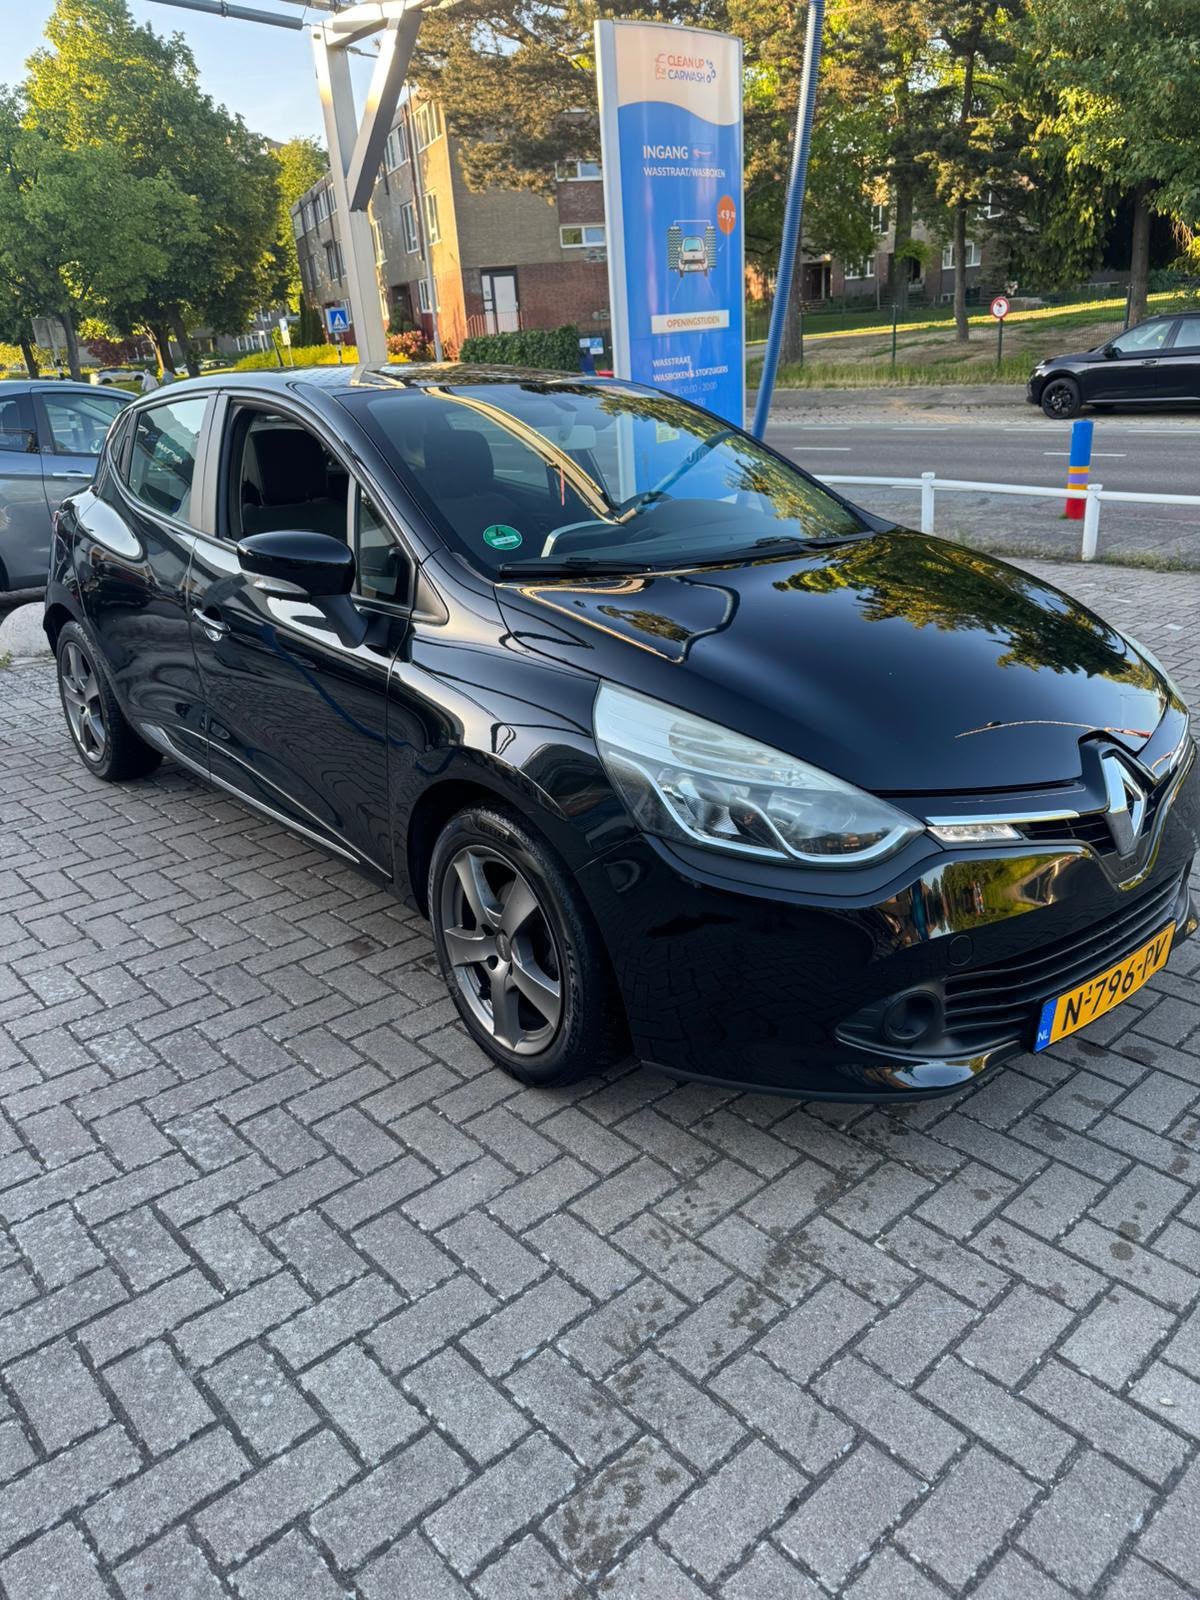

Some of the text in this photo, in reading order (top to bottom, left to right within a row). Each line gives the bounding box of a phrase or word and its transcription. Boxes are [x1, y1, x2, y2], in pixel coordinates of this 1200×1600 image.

[668, 69, 706, 83] CARWASH
[643, 145, 689, 160] INGANG
[1037, 1029, 1049, 1042] NL
